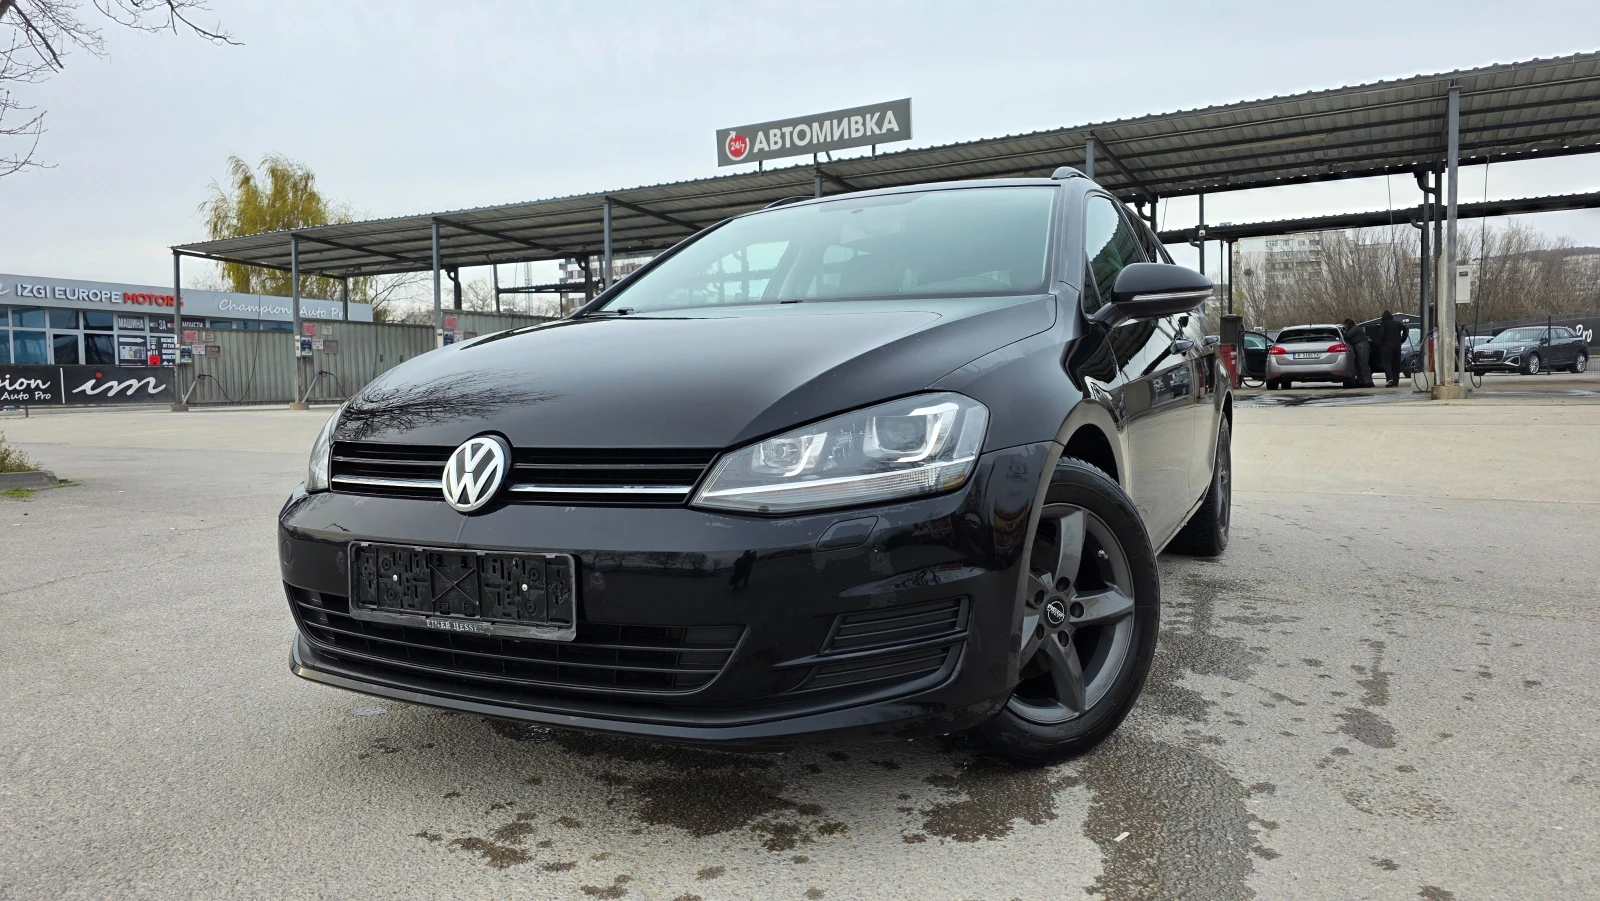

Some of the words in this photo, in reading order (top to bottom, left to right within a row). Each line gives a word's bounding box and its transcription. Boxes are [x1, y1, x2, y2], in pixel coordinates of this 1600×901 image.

[730, 140, 746, 153] 24/7
[753, 110, 899, 153] АВТОМИВКА
[16, 283, 50, 298] IZGI
[54, 286, 122, 303] EUROPE
[219, 299, 292, 316] Champion
[300, 306, 326, 317] Auto
[331, 307, 349, 319] Pr
[118, 318, 145, 329] МАШИНА
[158, 319, 167, 330] ЗА
[1575, 324, 1593, 343] Pro
[0, 374, 51, 391] ion
[1, 391, 30, 401] Auto
[34, 391, 52, 401] Pro
[452, 622, 485, 633] HESSE
